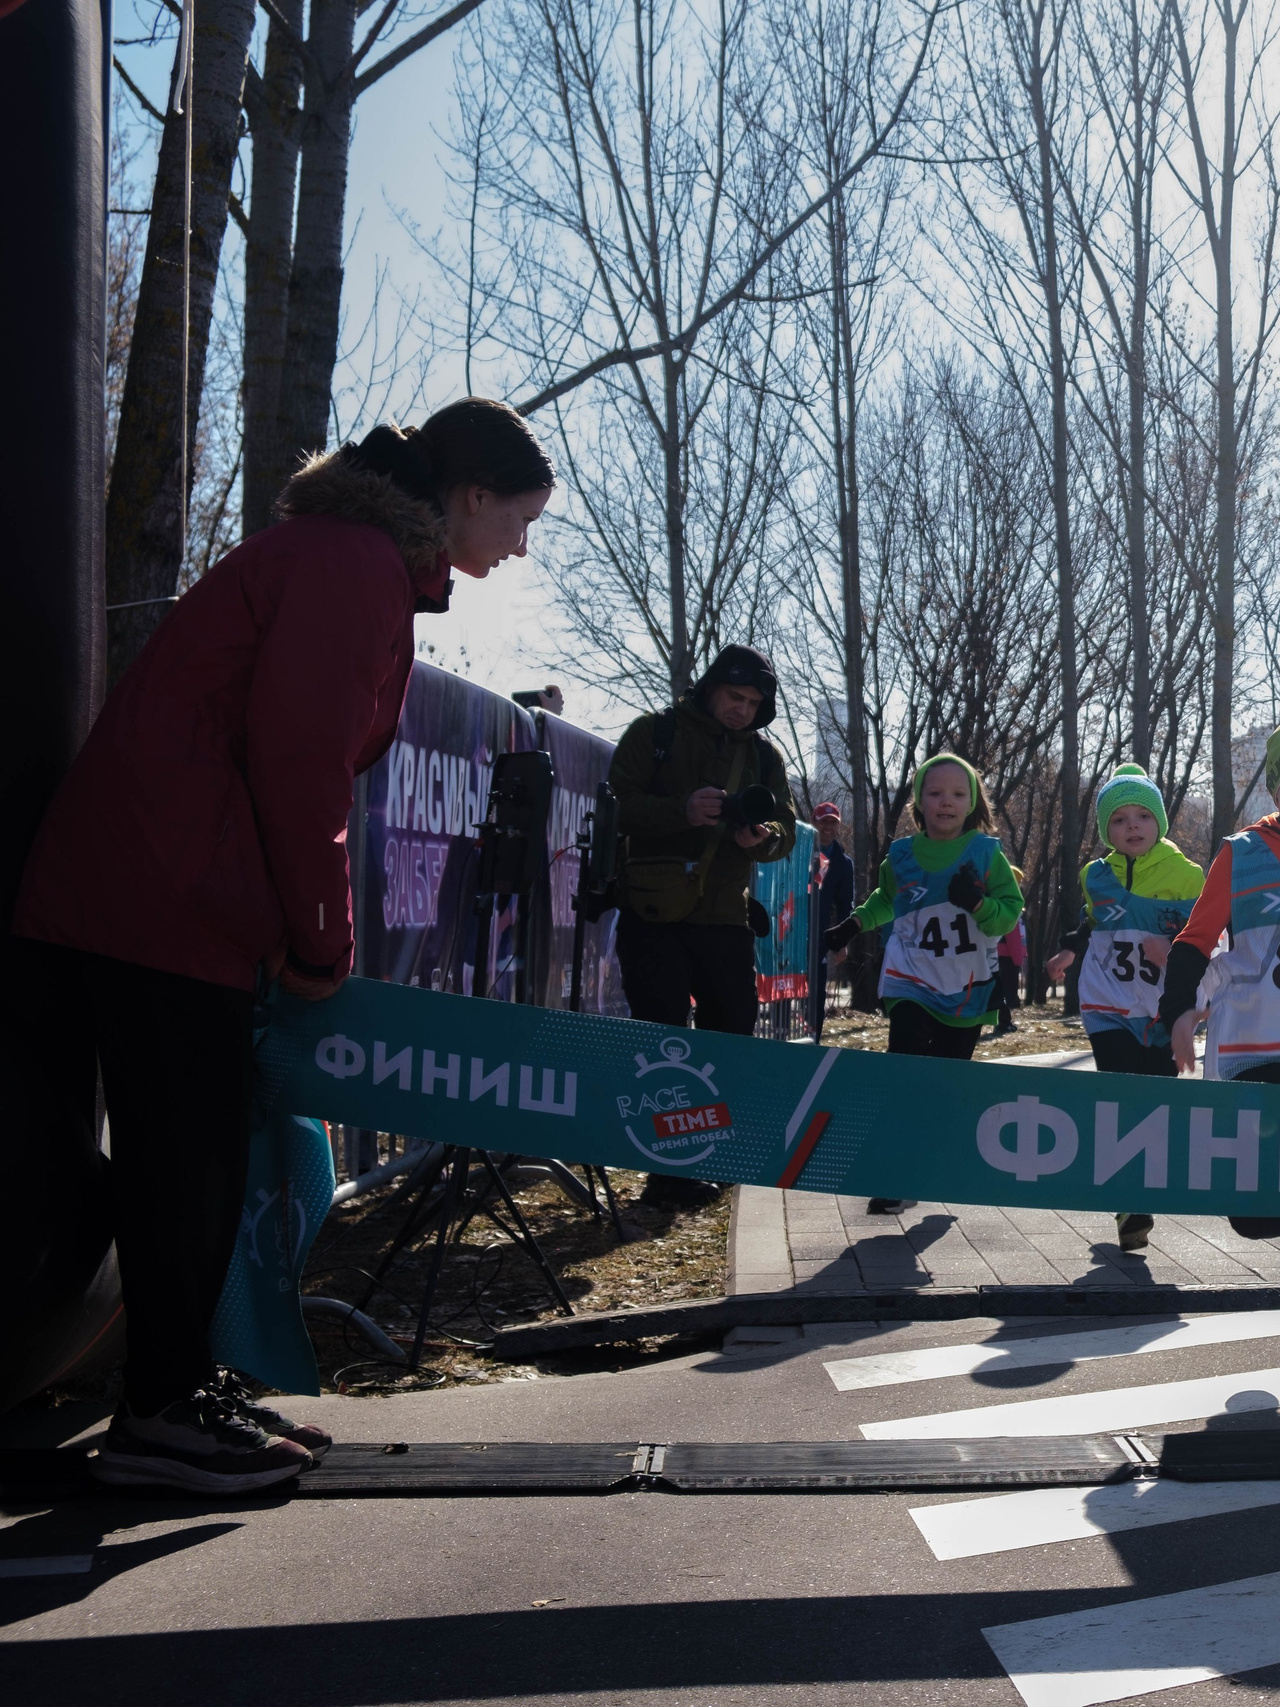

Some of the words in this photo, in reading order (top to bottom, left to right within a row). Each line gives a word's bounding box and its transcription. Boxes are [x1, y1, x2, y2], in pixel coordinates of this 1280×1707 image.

[551, 784, 597, 858] КРАСИ
[383, 839, 449, 929] ЗАБЕ
[919, 913, 977, 957] 41
[1112, 941, 1161, 986] 35
[315, 1033, 578, 1117] ФИНИШ
[616, 1085, 691, 1118] RACE
[663, 1108, 719, 1133] TIME
[651, 1137, 689, 1152] ВРЕМЯ
